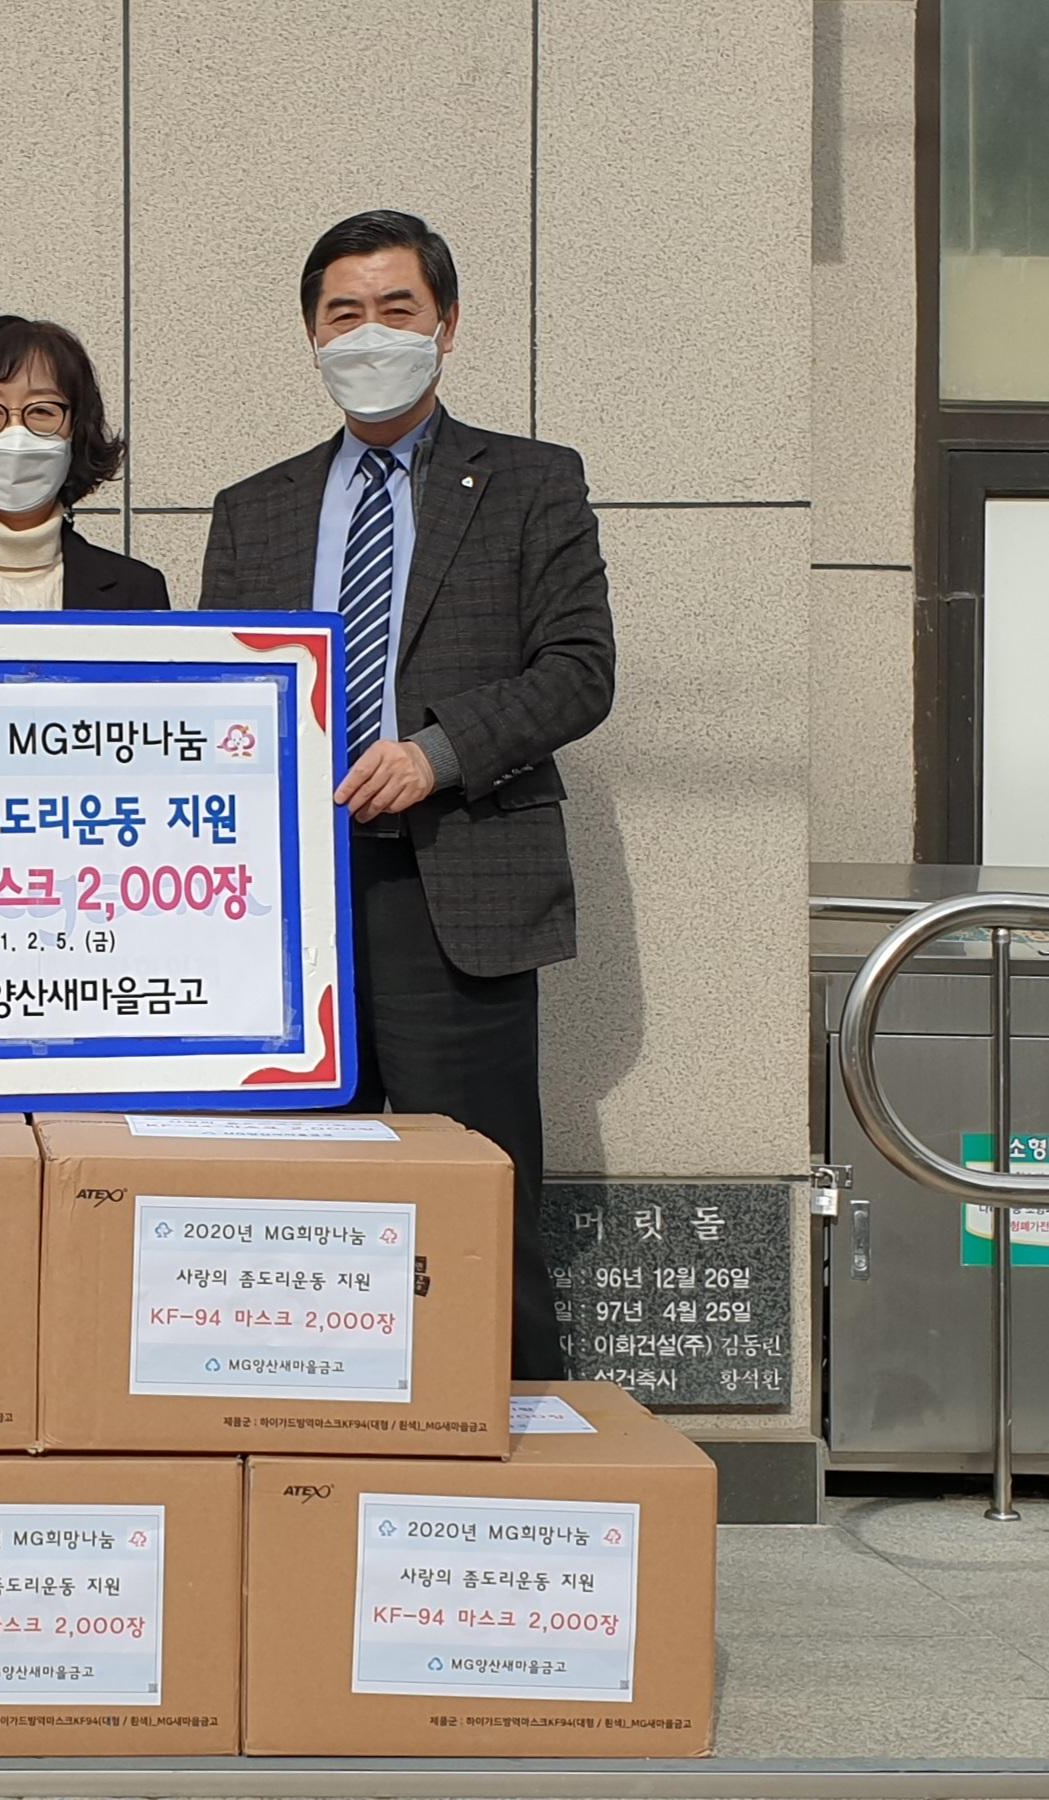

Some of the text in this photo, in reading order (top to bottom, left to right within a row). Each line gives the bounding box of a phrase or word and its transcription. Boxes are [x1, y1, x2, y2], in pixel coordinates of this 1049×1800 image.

[10, 720, 207, 763] MG희망나눔
[167, 795, 236, 844] 지원
[78, 864, 252, 921] 2,000장
[28, 932, 44, 951] 2.
[57, 932, 73, 951] 5.
[86, 930, 115, 953] (금)
[184, 1224, 366, 1245] 2020년 MG희망나눔
[177, 1269, 369, 1291] 사랑의 좀도리운동 지원
[597, 1267, 642, 1288] 96년
[653, 1267, 695, 1288] 12월
[705, 1265, 749, 1288] 26일
[151, 1308, 395, 1334] KF-94 마스크 2,000장
[597, 1301, 642, 1322] 97년
[663, 1301, 696, 1322] 4월
[706, 1301, 750, 1322] 25일
[595, 1334, 712, 1356] 이화건설(주)
[229, 1359, 344, 1375] MG양산새마을금고
[14, 1530, 115, 1550] MG희망나눔
[408, 1522, 590, 1546] 2020년 MG희망나눔
[88, 1578, 119, 1596] 지원
[401, 1568, 593, 1592] 사랑의 좀도리운동 지원
[55, 1617, 145, 1638] 2,000장
[374, 1607, 619, 1635] KF-94 마스크 2,000장
[452, 1659, 566, 1674] MG양산새마을금고
